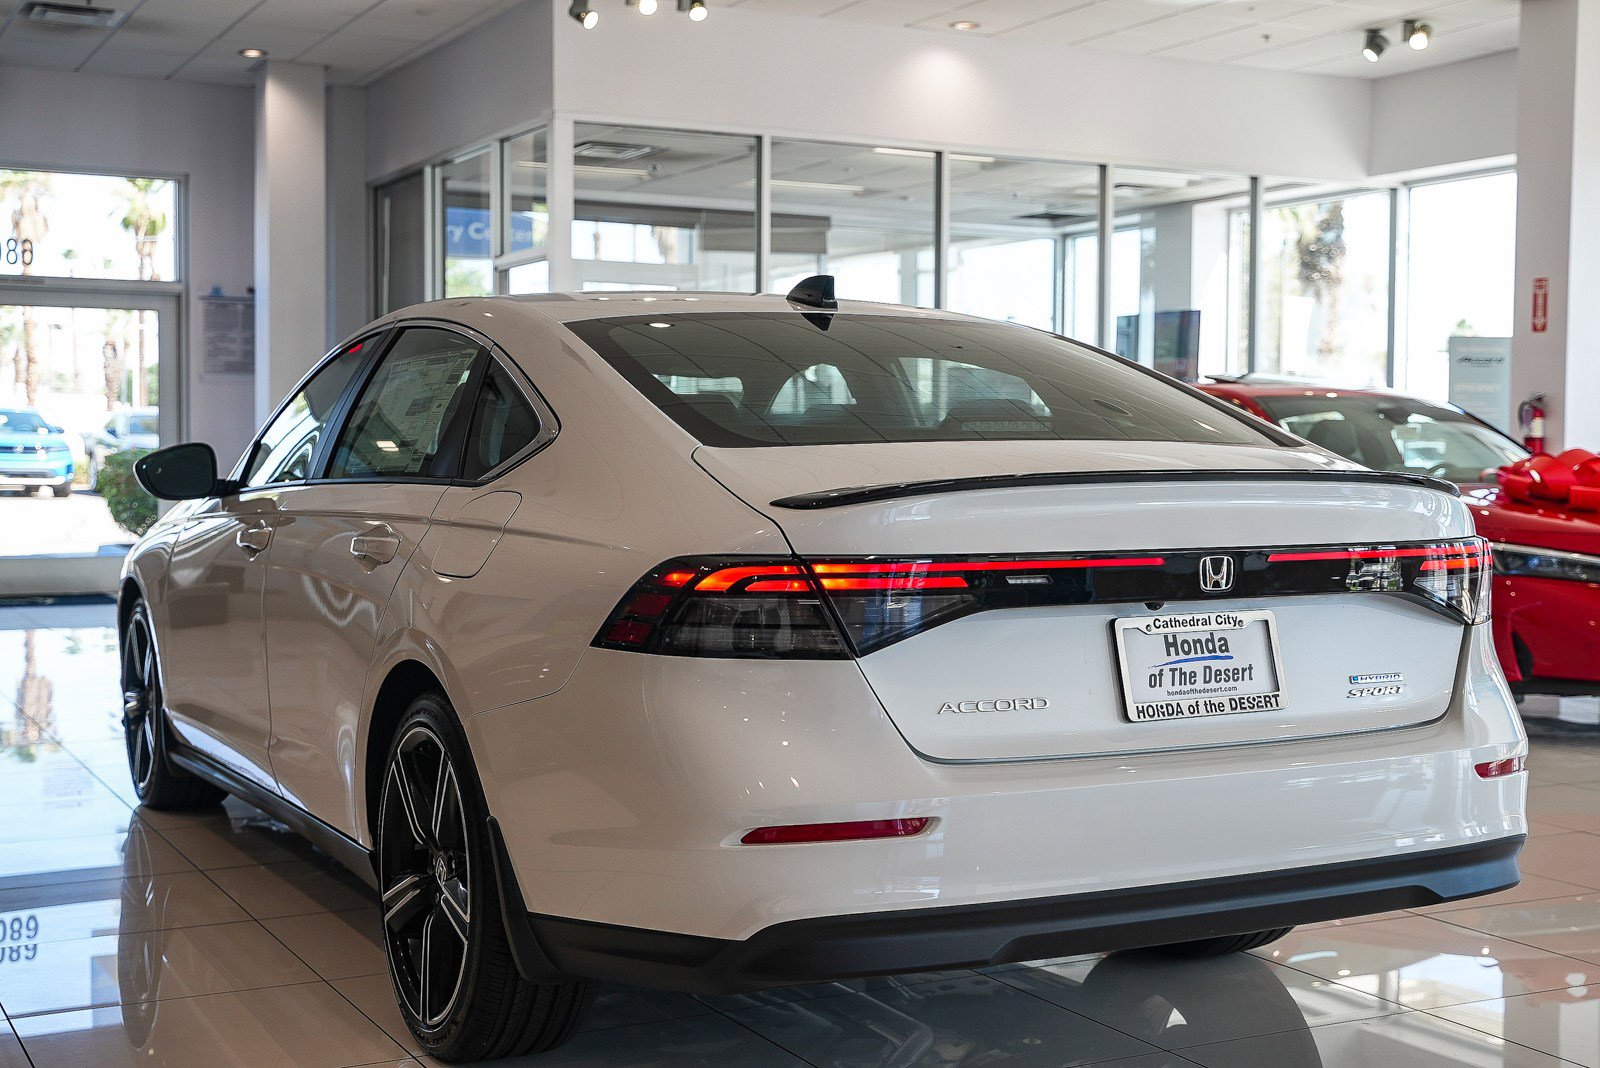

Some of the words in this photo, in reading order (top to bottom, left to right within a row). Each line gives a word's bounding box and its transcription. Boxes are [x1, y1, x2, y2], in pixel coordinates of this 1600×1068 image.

[1153, 615, 1212, 630] Cathedral
[1215, 613, 1239, 628] City
[1163, 632, 1230, 657] Honda
[1148, 668, 1164, 689] of
[1169, 667, 1197, 687] The
[1203, 663, 1254, 685] Desert
[1360, 674, 1401, 682] HYBRID
[1166, 685, 1238, 697] hondaofthedesert.com
[1346, 684, 1407, 699] SPORT
[937, 697, 1051, 715] ACCORD
[1136, 702, 1185, 720] HONDA
[1187, 700, 1201, 715] of
[1203, 698, 1226, 714] the
[1228, 693, 1280, 712] DESERT
